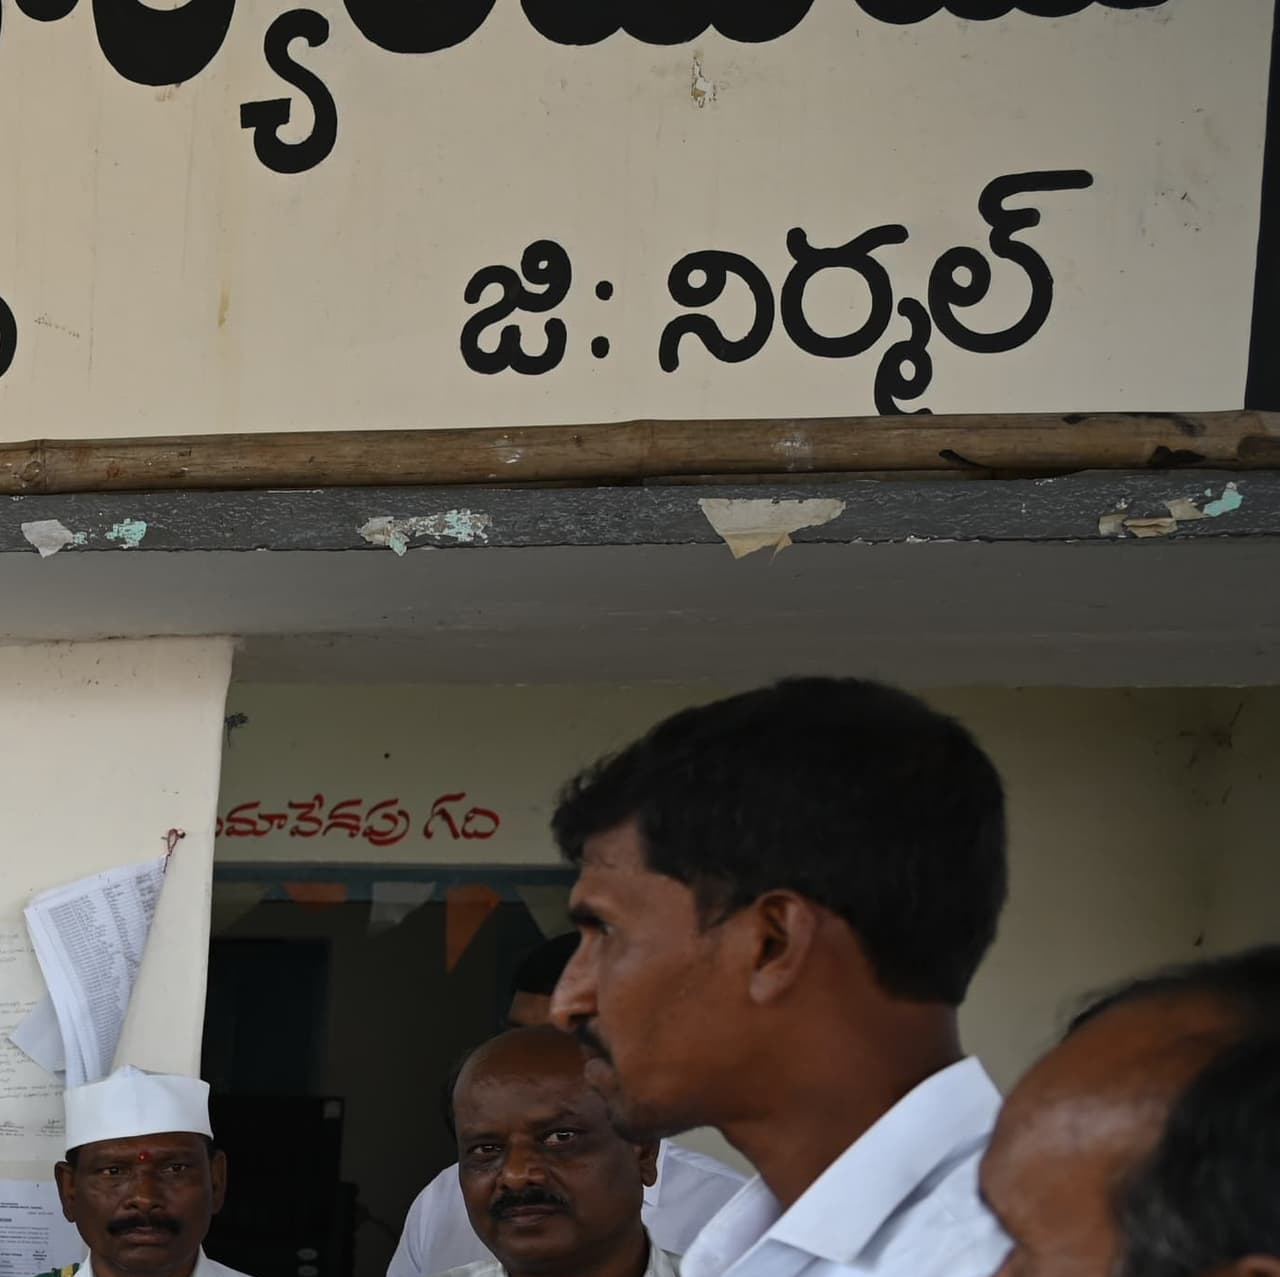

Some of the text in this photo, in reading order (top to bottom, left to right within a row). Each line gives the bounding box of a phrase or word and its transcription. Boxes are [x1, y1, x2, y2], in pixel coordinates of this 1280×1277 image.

[460, 239, 614, 376] జి:
[658, 169, 1094, 416] నిర్మల్
[215, 791, 502, 847] మావేశపు గది
